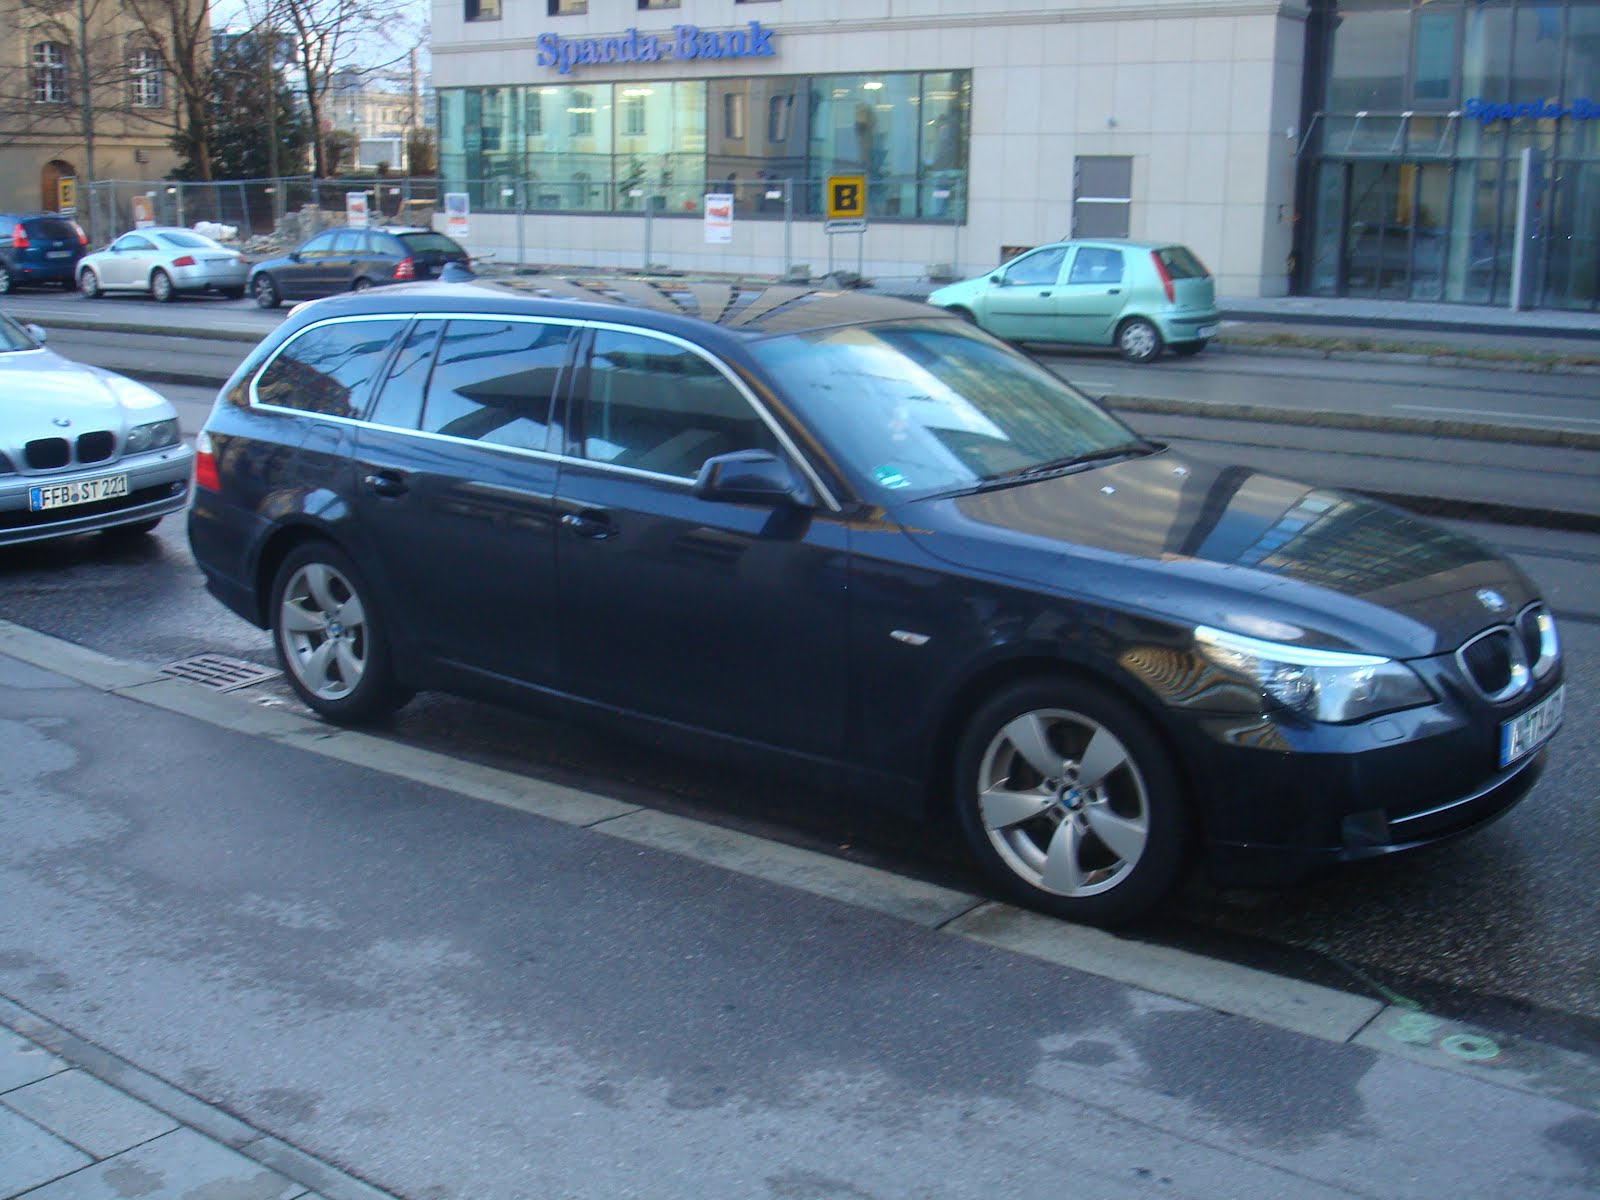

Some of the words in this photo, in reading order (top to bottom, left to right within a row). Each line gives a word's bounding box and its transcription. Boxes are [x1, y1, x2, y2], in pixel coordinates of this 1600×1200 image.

[536, 21, 775, 75] Sparda-Bank
[835, 184, 858, 211] B
[42, 486, 70, 507] FFB
[81, 481, 99, 500] ST
[102, 476, 126, 497] 221
